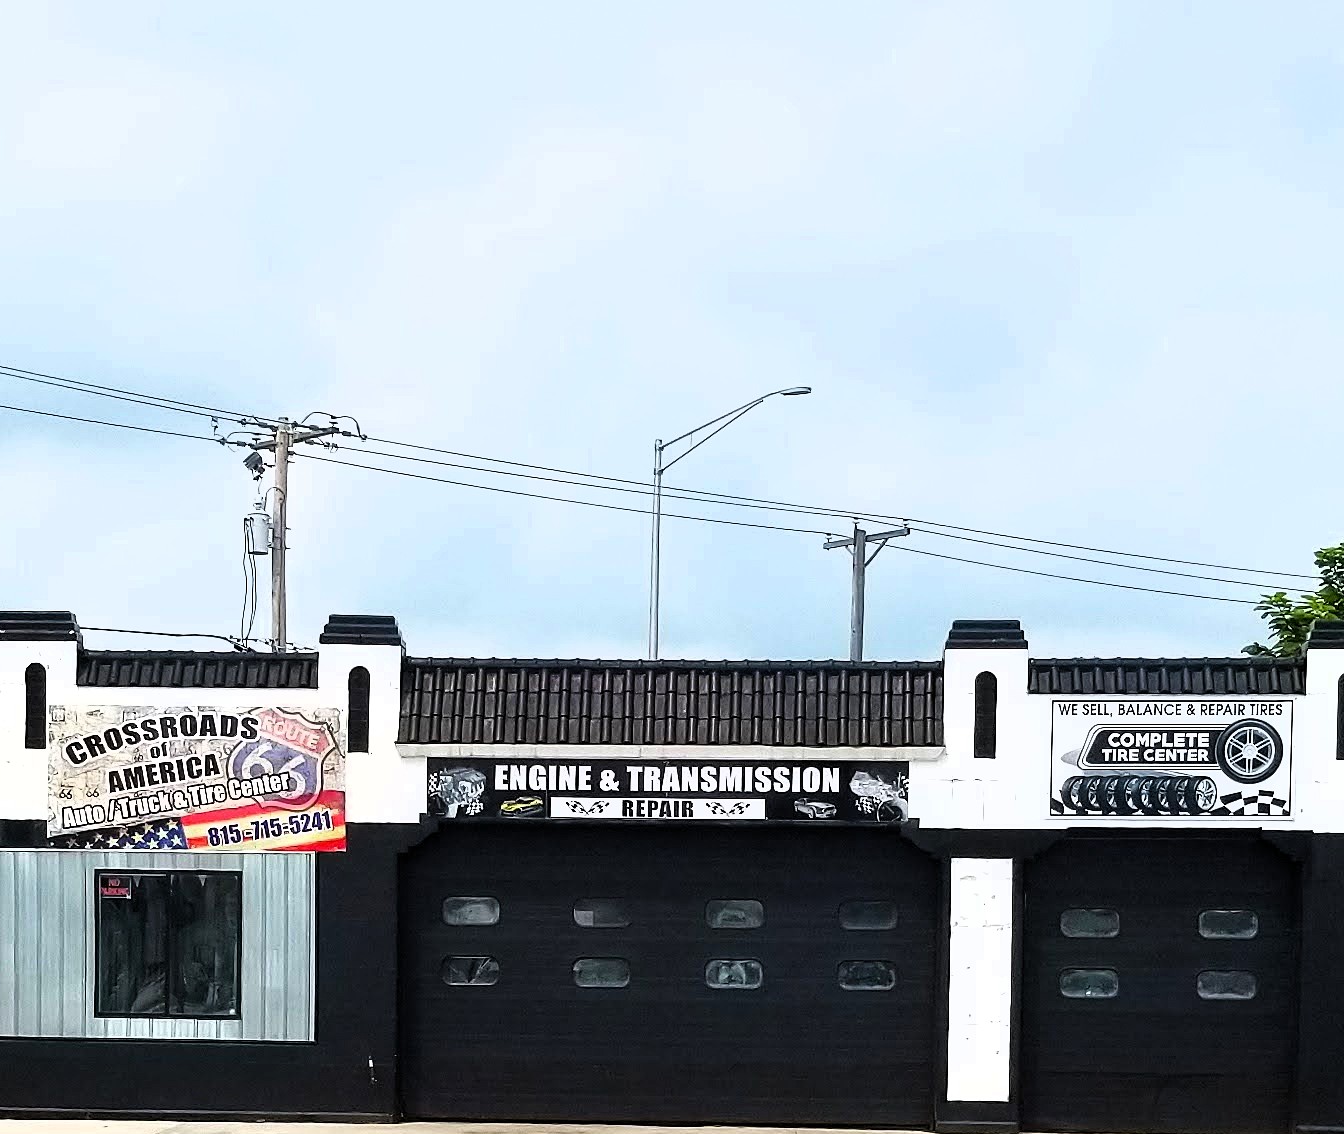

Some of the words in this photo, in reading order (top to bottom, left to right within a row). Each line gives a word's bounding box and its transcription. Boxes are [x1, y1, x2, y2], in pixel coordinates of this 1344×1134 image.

[1058, 703, 1078, 716] WE
[1082, 703, 1113, 717] SELL,
[1118, 703, 1182, 716] BALANCE
[1186, 703, 1196, 716] &
[1200, 703, 1246, 716] REPAIR
[1250, 703, 1284, 716] TIRES
[65, 714, 259, 765] CROSSROADS
[261, 716, 321, 749] ROUTE
[1107, 732, 1210, 748] COMPLETE
[150, 742, 168, 759] of
[1102, 748, 1140, 762] TIRE
[1143, 748, 1209, 762] CENTER
[108, 753, 221, 793] AMERICA
[241, 741, 306, 800] 66
[493, 764, 592, 792] ENGINE
[599, 769, 620, 792] &
[626, 766, 841, 793] TRANSMISSION
[62, 804, 106, 829] Auto
[117, 790, 173, 819] Truck
[173, 790, 189, 810] &
[187, 783, 227, 808] Tire
[227, 772, 290, 800] Center
[620, 798, 695, 819] REPAIR
[208, 811, 333, 847] 815-715-5241
